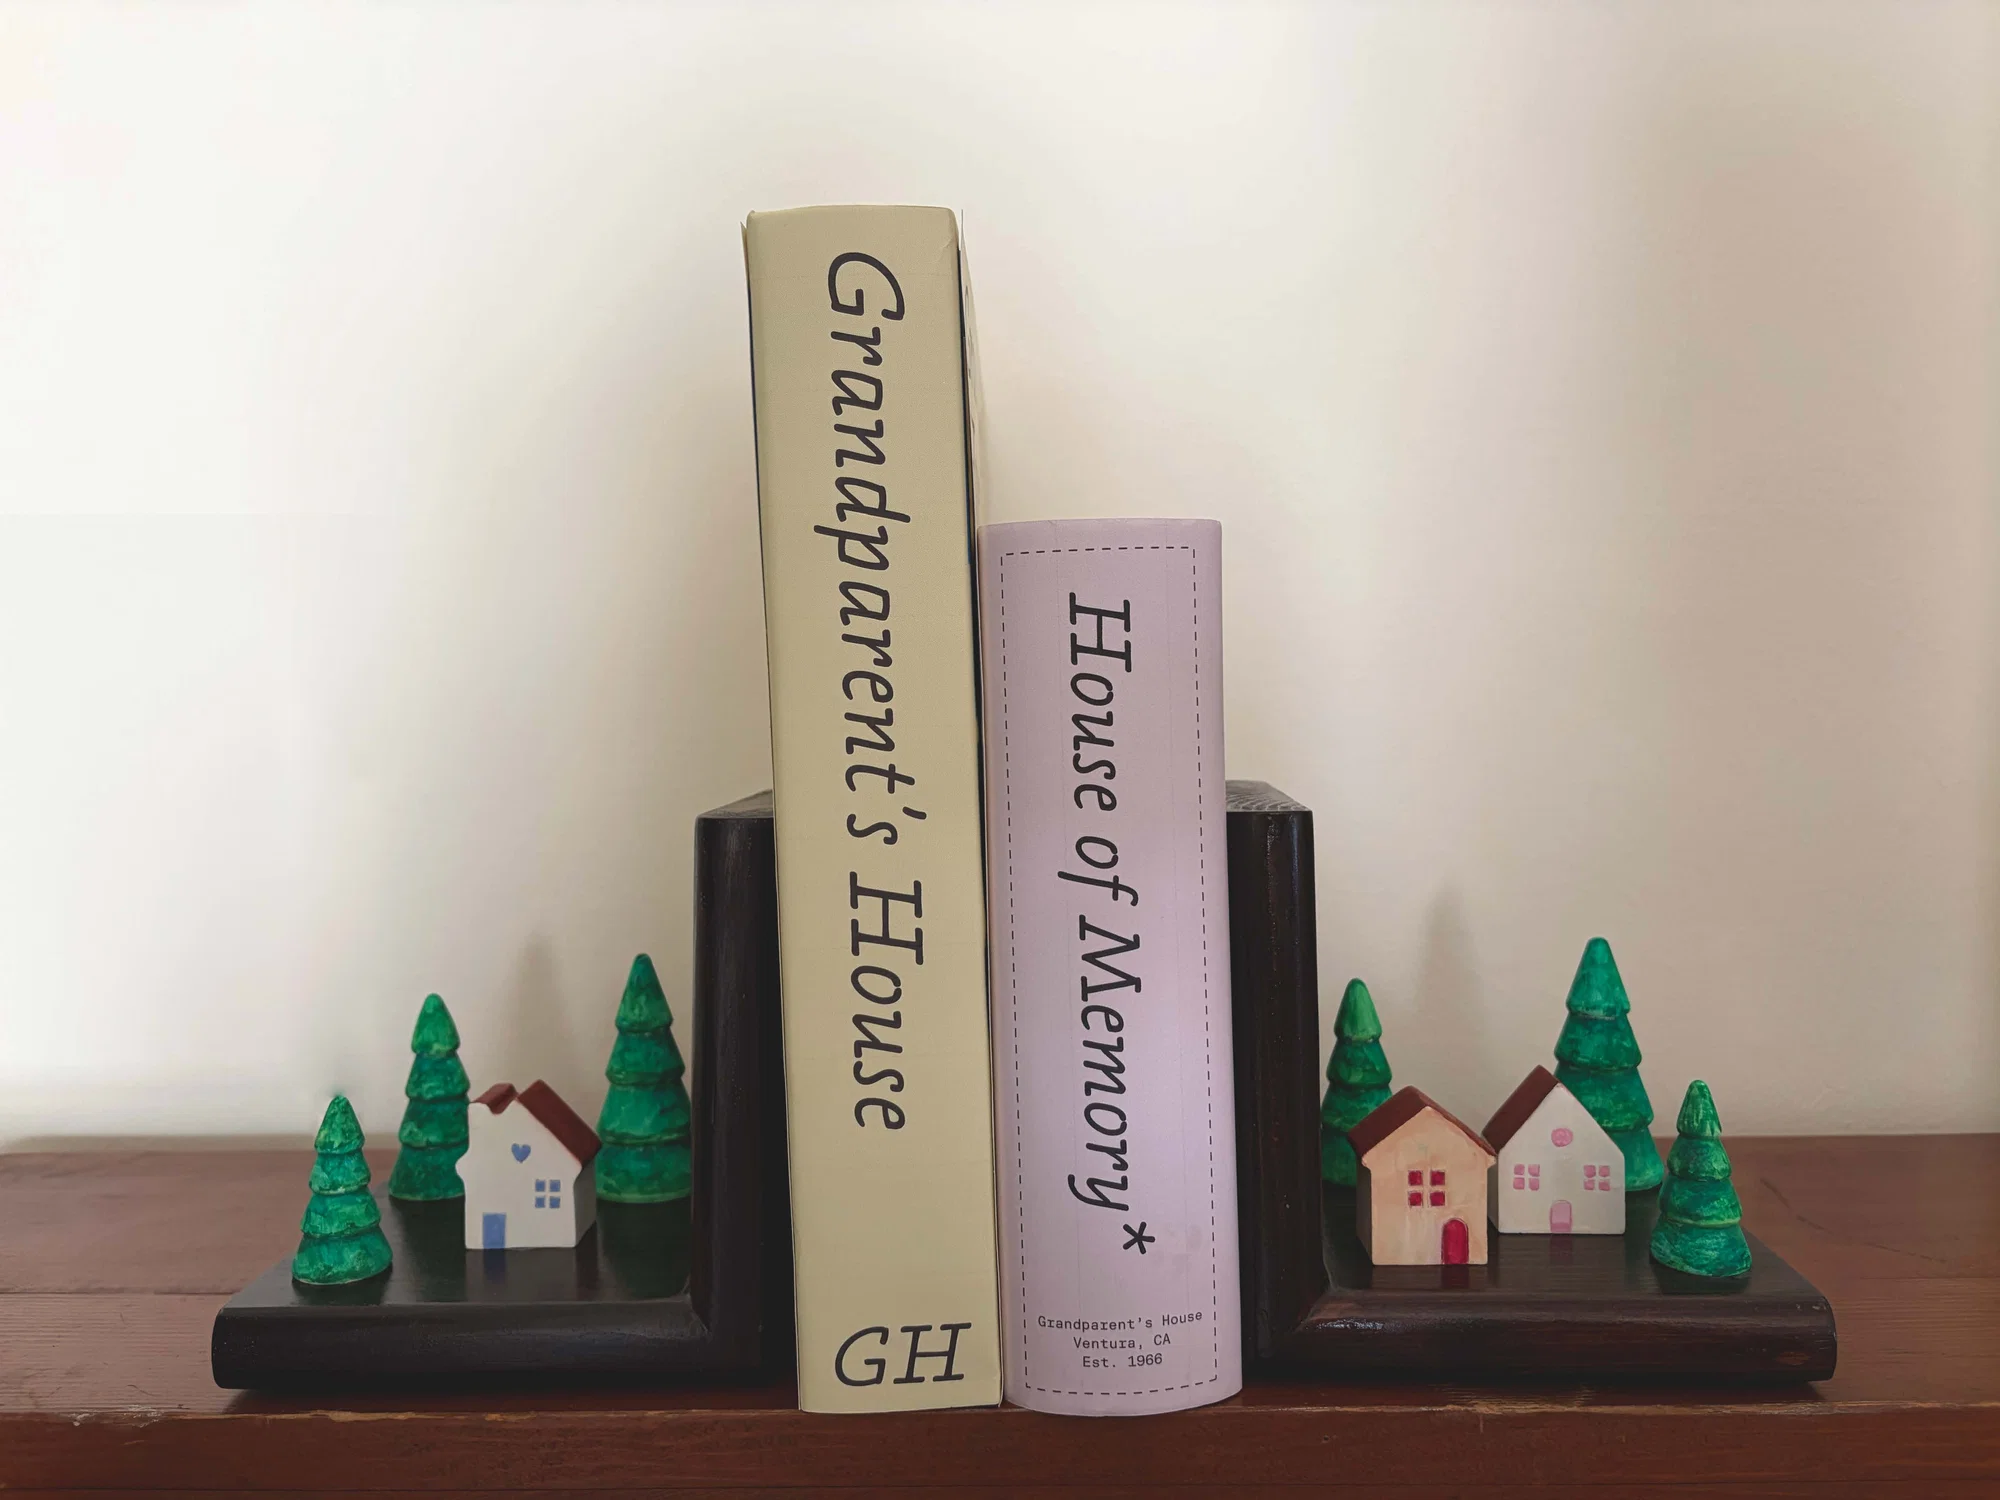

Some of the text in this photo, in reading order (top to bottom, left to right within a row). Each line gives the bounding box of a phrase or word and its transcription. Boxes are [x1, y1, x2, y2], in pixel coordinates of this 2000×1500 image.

[813, 251, 927, 1130] Grandparent's House
[1069, 591, 1132, 812] House
[1057, 835, 1139, 907] of
[834, 1322, 972, 1387] GH
[1037, 1311, 1203, 1333] Grandparent's House
[1073, 1333, 1171, 1350] Ventura, CA
[1082, 1352, 1163, 1368] Est. 1966
